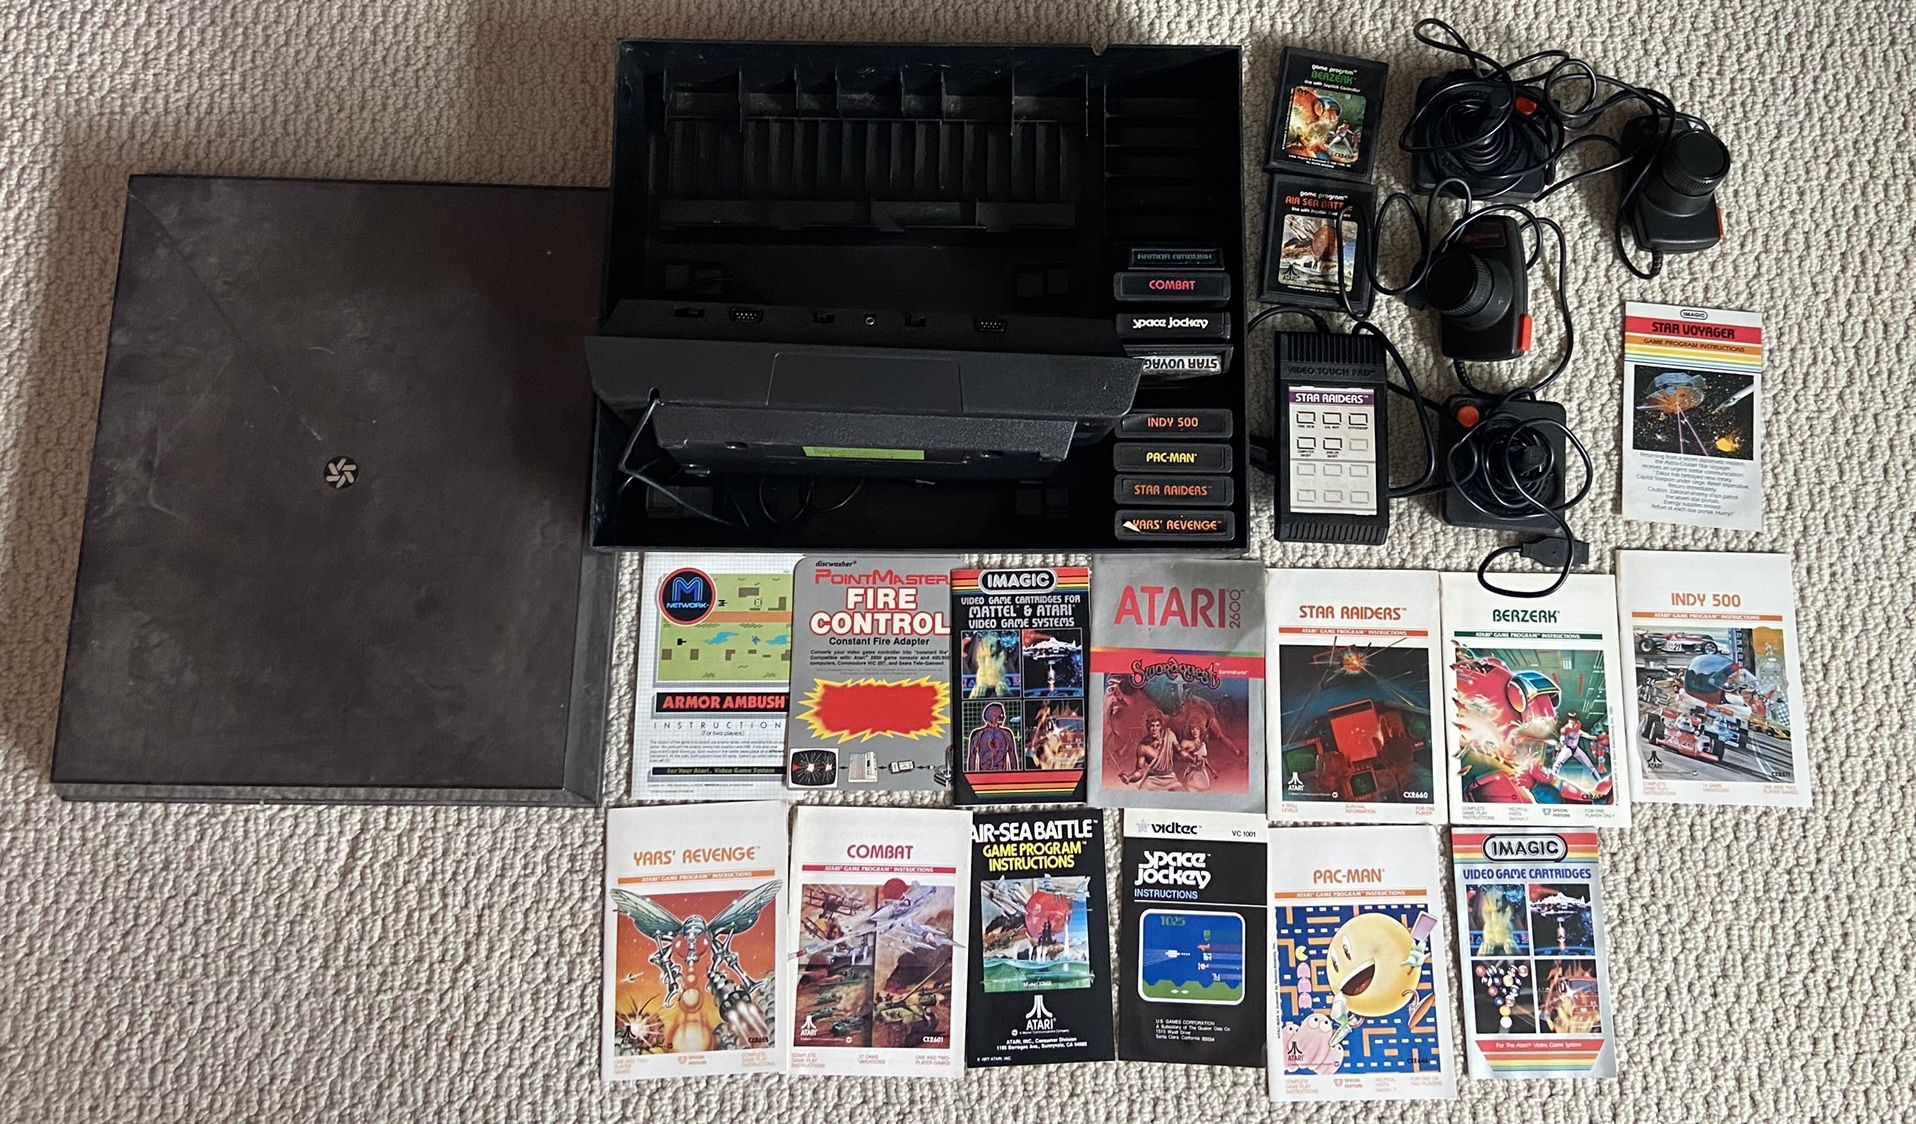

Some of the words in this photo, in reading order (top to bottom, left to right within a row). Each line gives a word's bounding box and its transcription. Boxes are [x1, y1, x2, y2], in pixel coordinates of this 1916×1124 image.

[1312, 70, 1352, 84] BERZERK
[1285, 196, 1300, 204] AIR
[1302, 198, 1319, 207] SEA
[1149, 280, 1196, 290] COMBAT
[1168, 317, 1209, 329] jockey
[1652, 322, 1680, 334] STAR
[1683, 325, 1735, 339] VOYAGER
[1665, 340, 1698, 348] PROGRAM
[1700, 343, 1745, 353] INSTRUCTIONS
[1143, 358, 1185, 369] VOYAG
[1188, 358, 1218, 369] STAR
[1287, 365, 1314, 374] VIDEO
[1317, 367, 1349, 376] TOUCH
[1352, 368, 1369, 377] PAD
[1295, 393, 1320, 402] STAR
[1322, 394, 1363, 404] RAIDERS
[1148, 417, 1174, 427] INDY
[1177, 418, 1199, 427] 500
[1146, 452, 1195, 463] PAC-MAN
[1134, 485, 1160, 495] STAR
[1164, 485, 1208, 495] RAIDERS
[1167, 520, 1217, 530] REVENGE
[987, 573, 1050, 588] IMAGIC
[846, 587, 918, 610] FIRE
[960, 597, 985, 605] VIDEO
[988, 596, 1012, 604] GAME
[1015, 595, 1062, 604] CARTRIDGES
[1064, 595, 1080, 603] FOR
[1671, 592, 1706, 606] INDY
[1712, 594, 1741, 608] 500
[969, 605, 1016, 618] MATTEL
[1024, 605, 1032, 616] &
[1037, 604, 1072, 616] ATARI
[1114, 585, 1226, 628] ATARI
[1229, 589, 1241, 628] 2600
[1299, 605, 1335, 618] STAR
[1341, 606, 1401, 620] RAIDERS
[1493, 609, 1558, 623] BERZERK
[810, 611, 951, 635] CONTROL
[968, 619, 996, 629] VIDEO
[1001, 618, 1029, 628] GAME
[1032, 617, 1075, 627] SYSTEMS
[829, 637, 871, 646] Constant
[873, 637, 891, 645] Fire
[893, 637, 930, 647] Adapter
[663, 696, 720, 709] ARMOR
[722, 696, 785, 708] AMBUSH
[971, 822, 1034, 843] AIR-SEA
[1034, 819, 1093, 840] BATTLE
[1152, 822, 1197, 835] vidtec
[847, 845, 913, 859] COMBAT
[983, 844, 1017, 858] GAME
[1019, 841, 1082, 856] PROGRAM
[1492, 841, 1559, 856] IMAGIC
[634, 850, 676, 866] YARS'
[682, 846, 756, 864] REVENGE
[989, 855, 1075, 872] INSTRUCTIONS
[1134, 866, 1211, 889] jockey
[1313, 868, 1382, 884] PAC-MAN
[1463, 869, 1494, 879] VIDEO
[1496, 869, 1526, 879] GAME
[1529, 868, 1591, 879] CARTRIDGES
[1134, 888, 1198, 899] INSTRUCTIONS
[1160, 916, 1186, 926] 1025
[1026, 1019, 1053, 1031] ATARI
